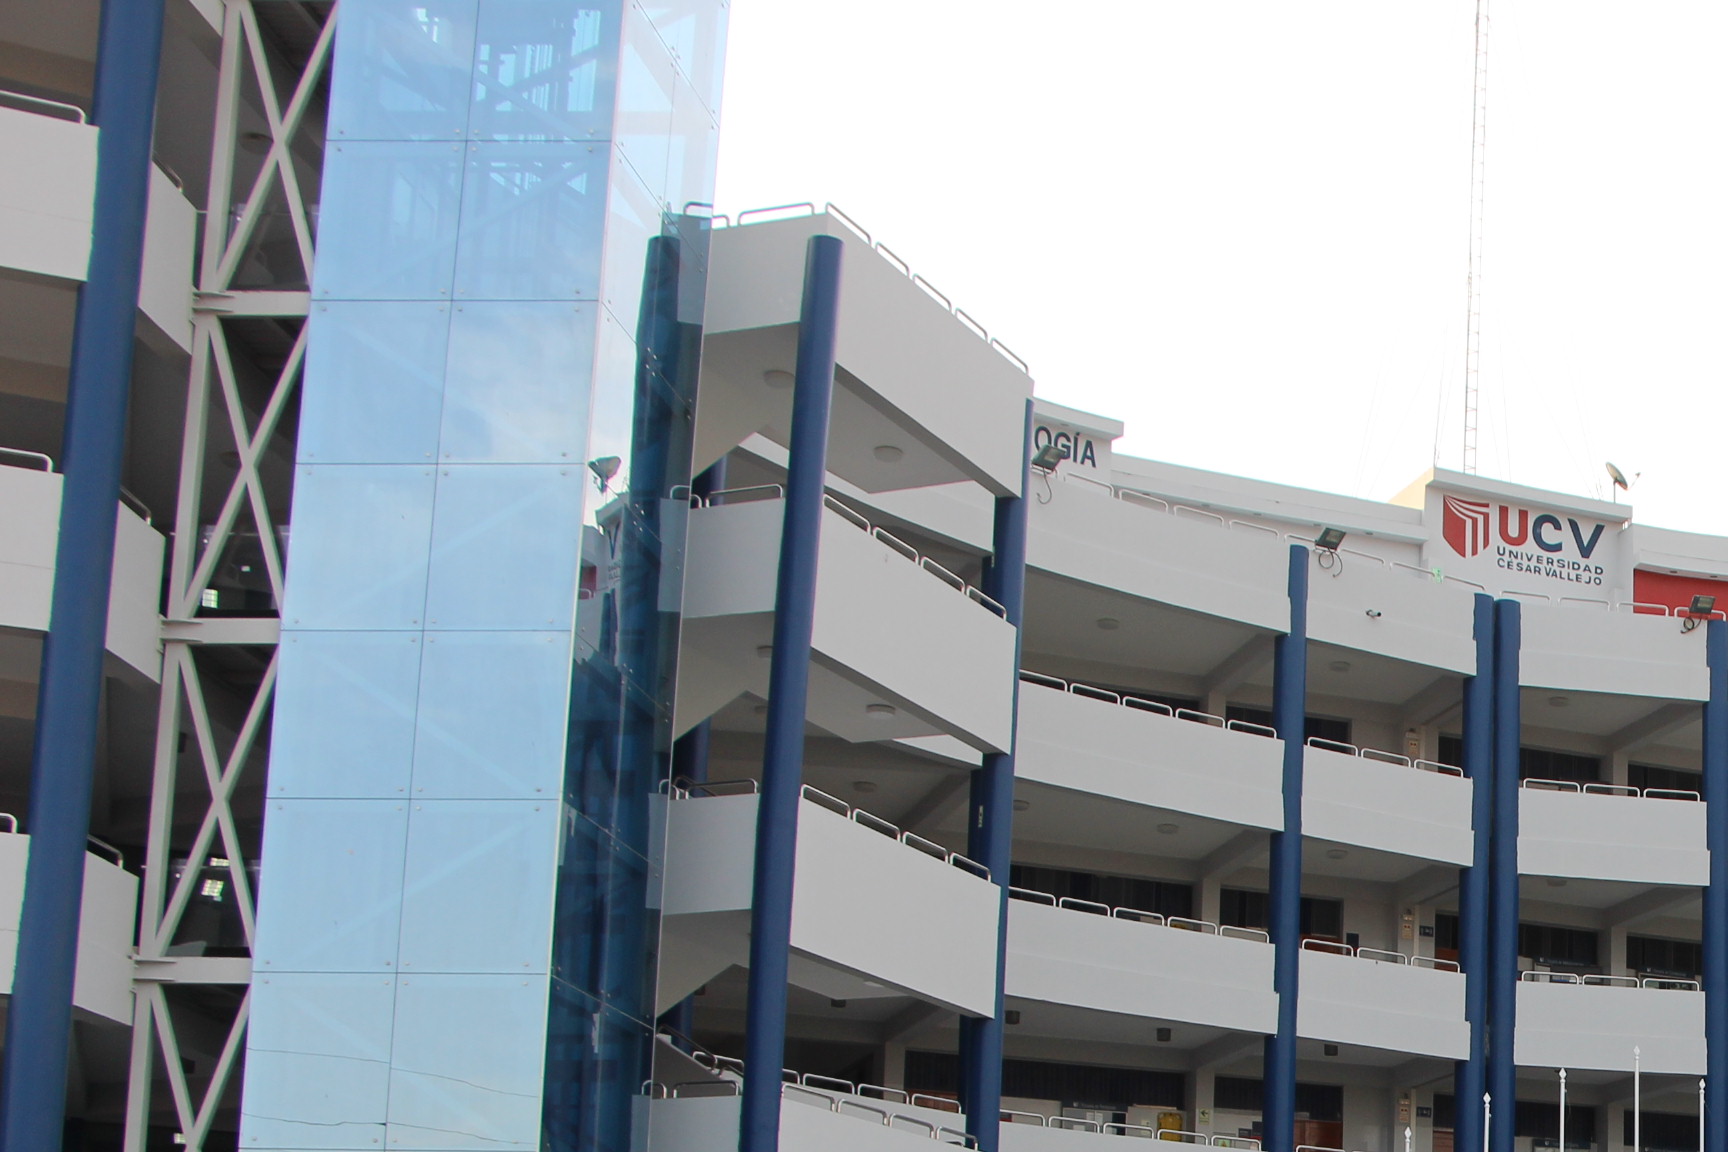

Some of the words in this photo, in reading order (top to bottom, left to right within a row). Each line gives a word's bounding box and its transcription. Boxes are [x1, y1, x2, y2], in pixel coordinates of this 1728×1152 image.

[1034, 425, 1097, 468] OGÍA
[1499, 504, 1605, 559] UCV
[1496, 545, 1604, 576] UNIVERSIDAD
[1496, 557, 1542, 576] CÉSAR
[1543, 565, 1603, 586] VALLEJO
